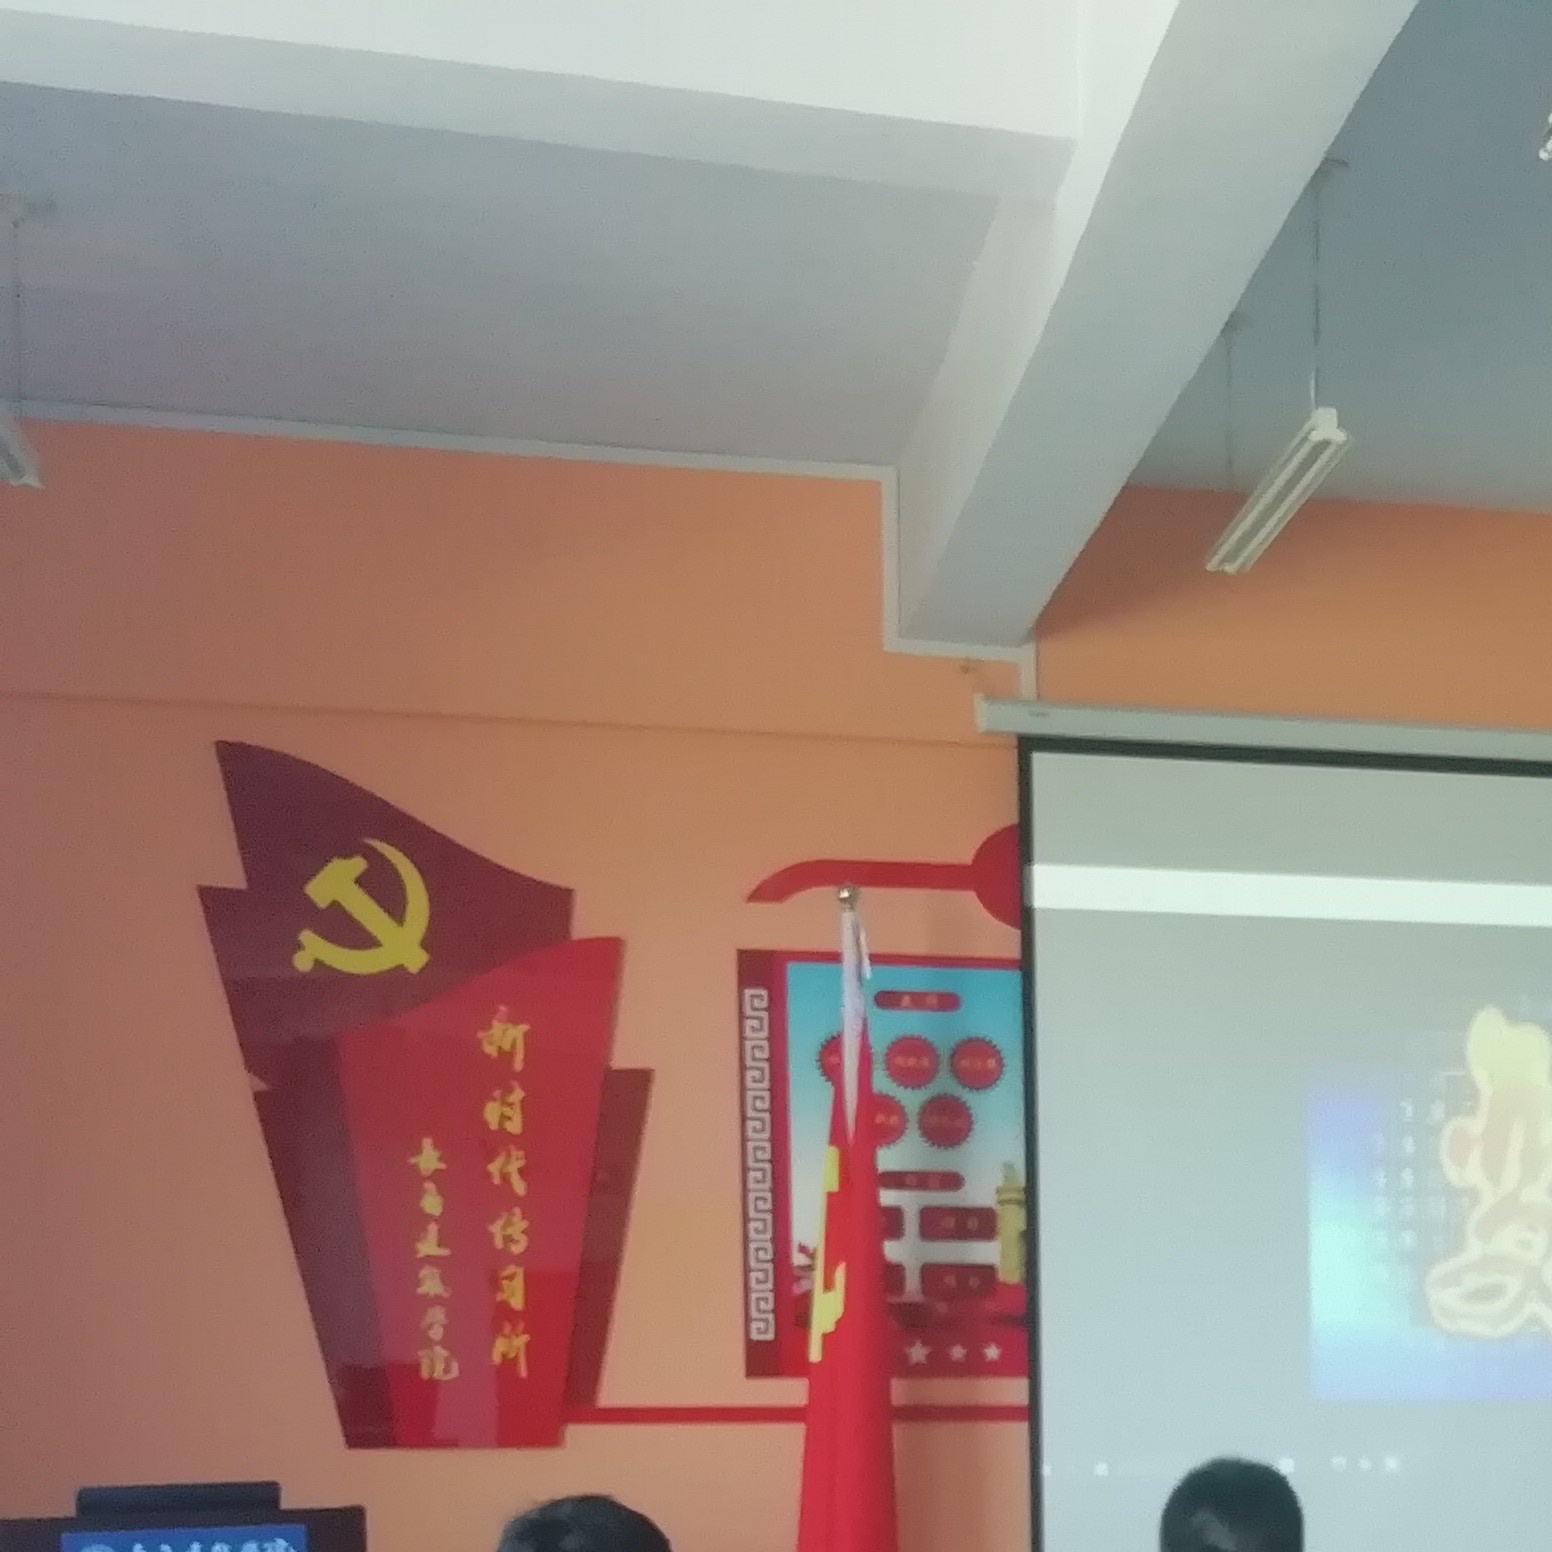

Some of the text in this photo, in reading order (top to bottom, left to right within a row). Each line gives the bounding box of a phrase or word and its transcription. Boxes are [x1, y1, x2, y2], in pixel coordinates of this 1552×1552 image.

[476, 1005, 530, 1380] 新时代传习所
